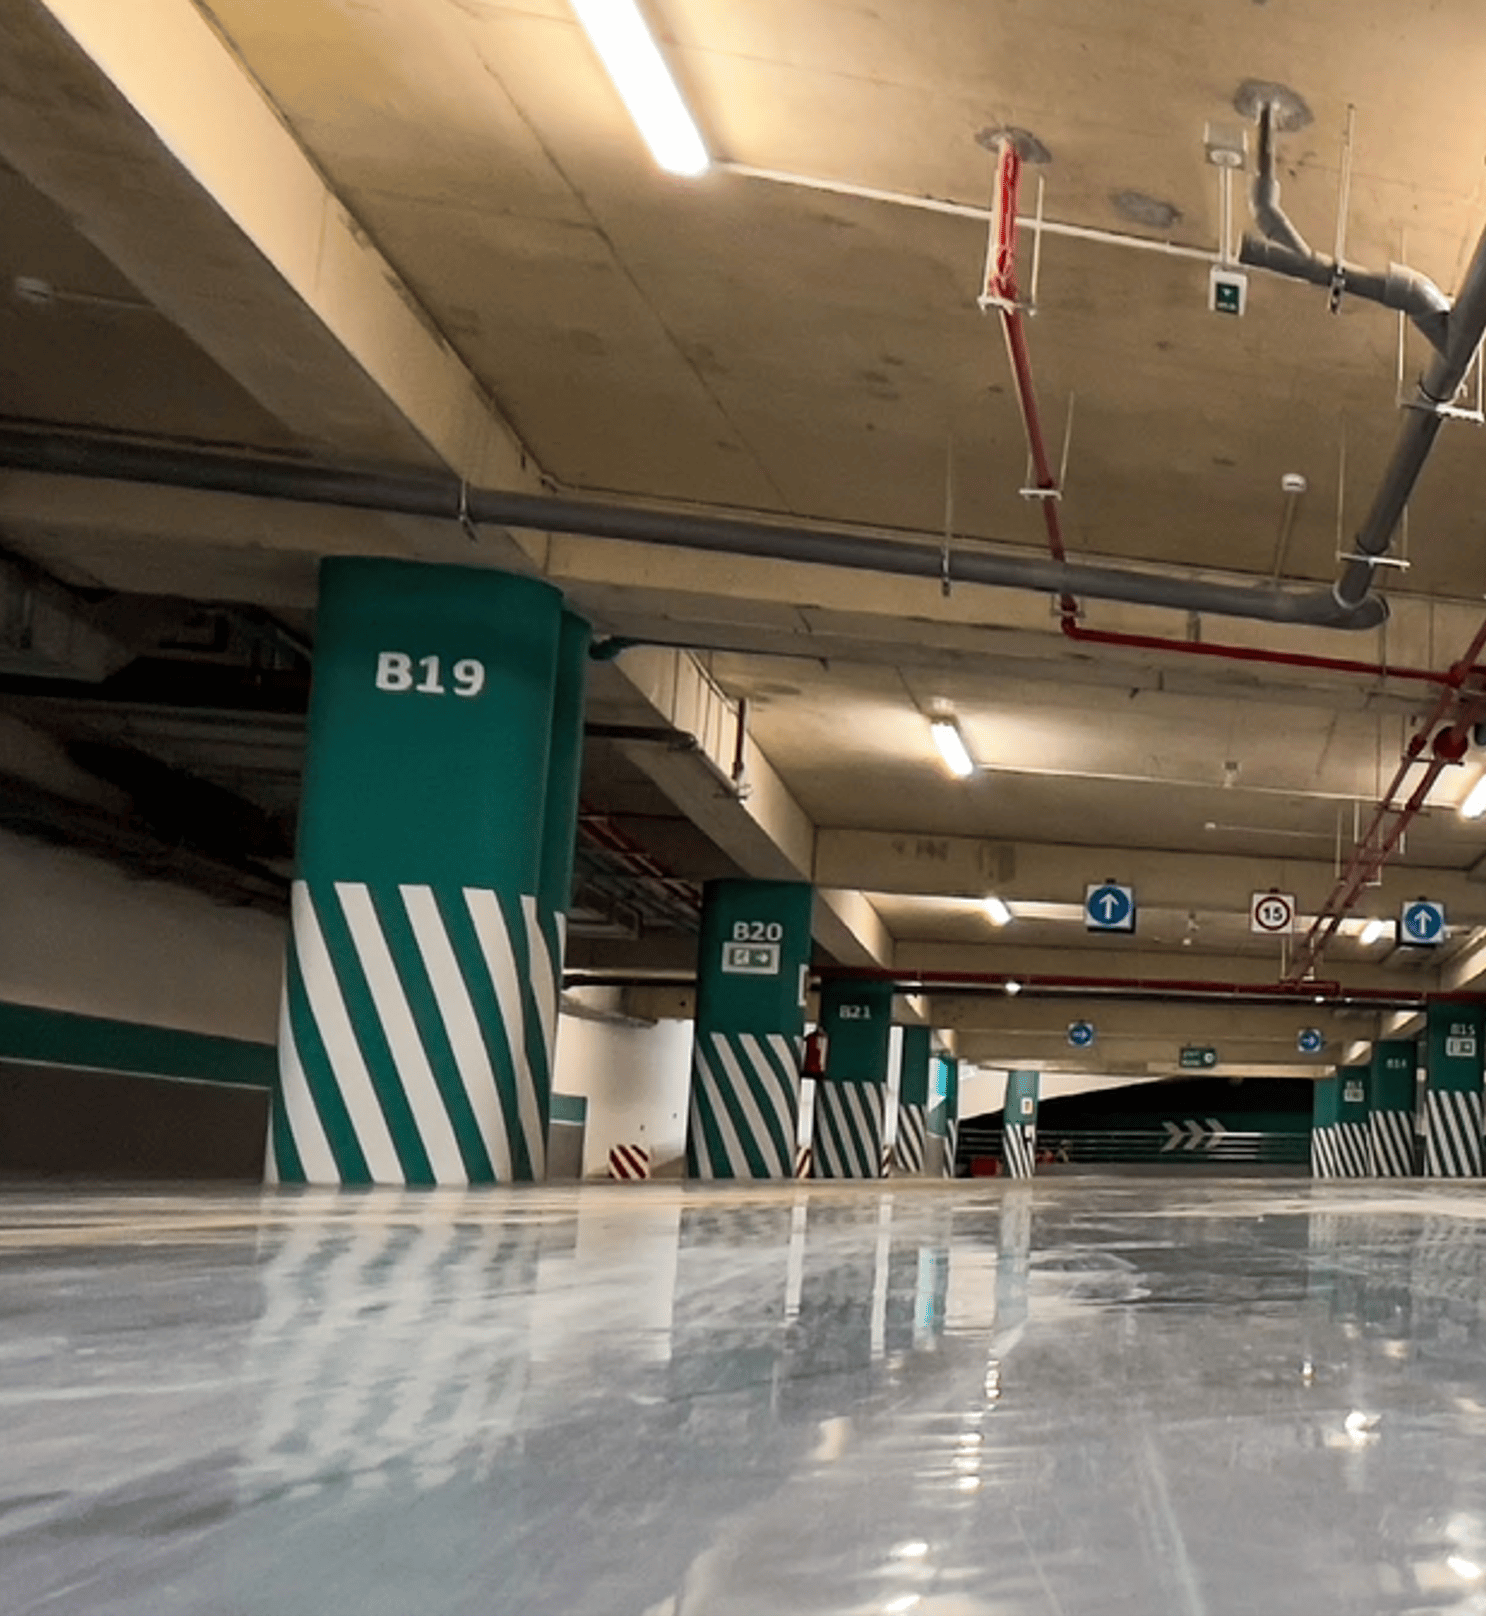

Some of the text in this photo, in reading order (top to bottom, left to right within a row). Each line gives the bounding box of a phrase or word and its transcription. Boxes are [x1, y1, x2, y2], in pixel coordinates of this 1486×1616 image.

[376, 652, 484, 697] B19
[1263, 906, 1283, 921] 15
[733, 921, 782, 941] B20
[839, 1005, 871, 1020] B21
[1450, 1023, 1475, 1036] B15
